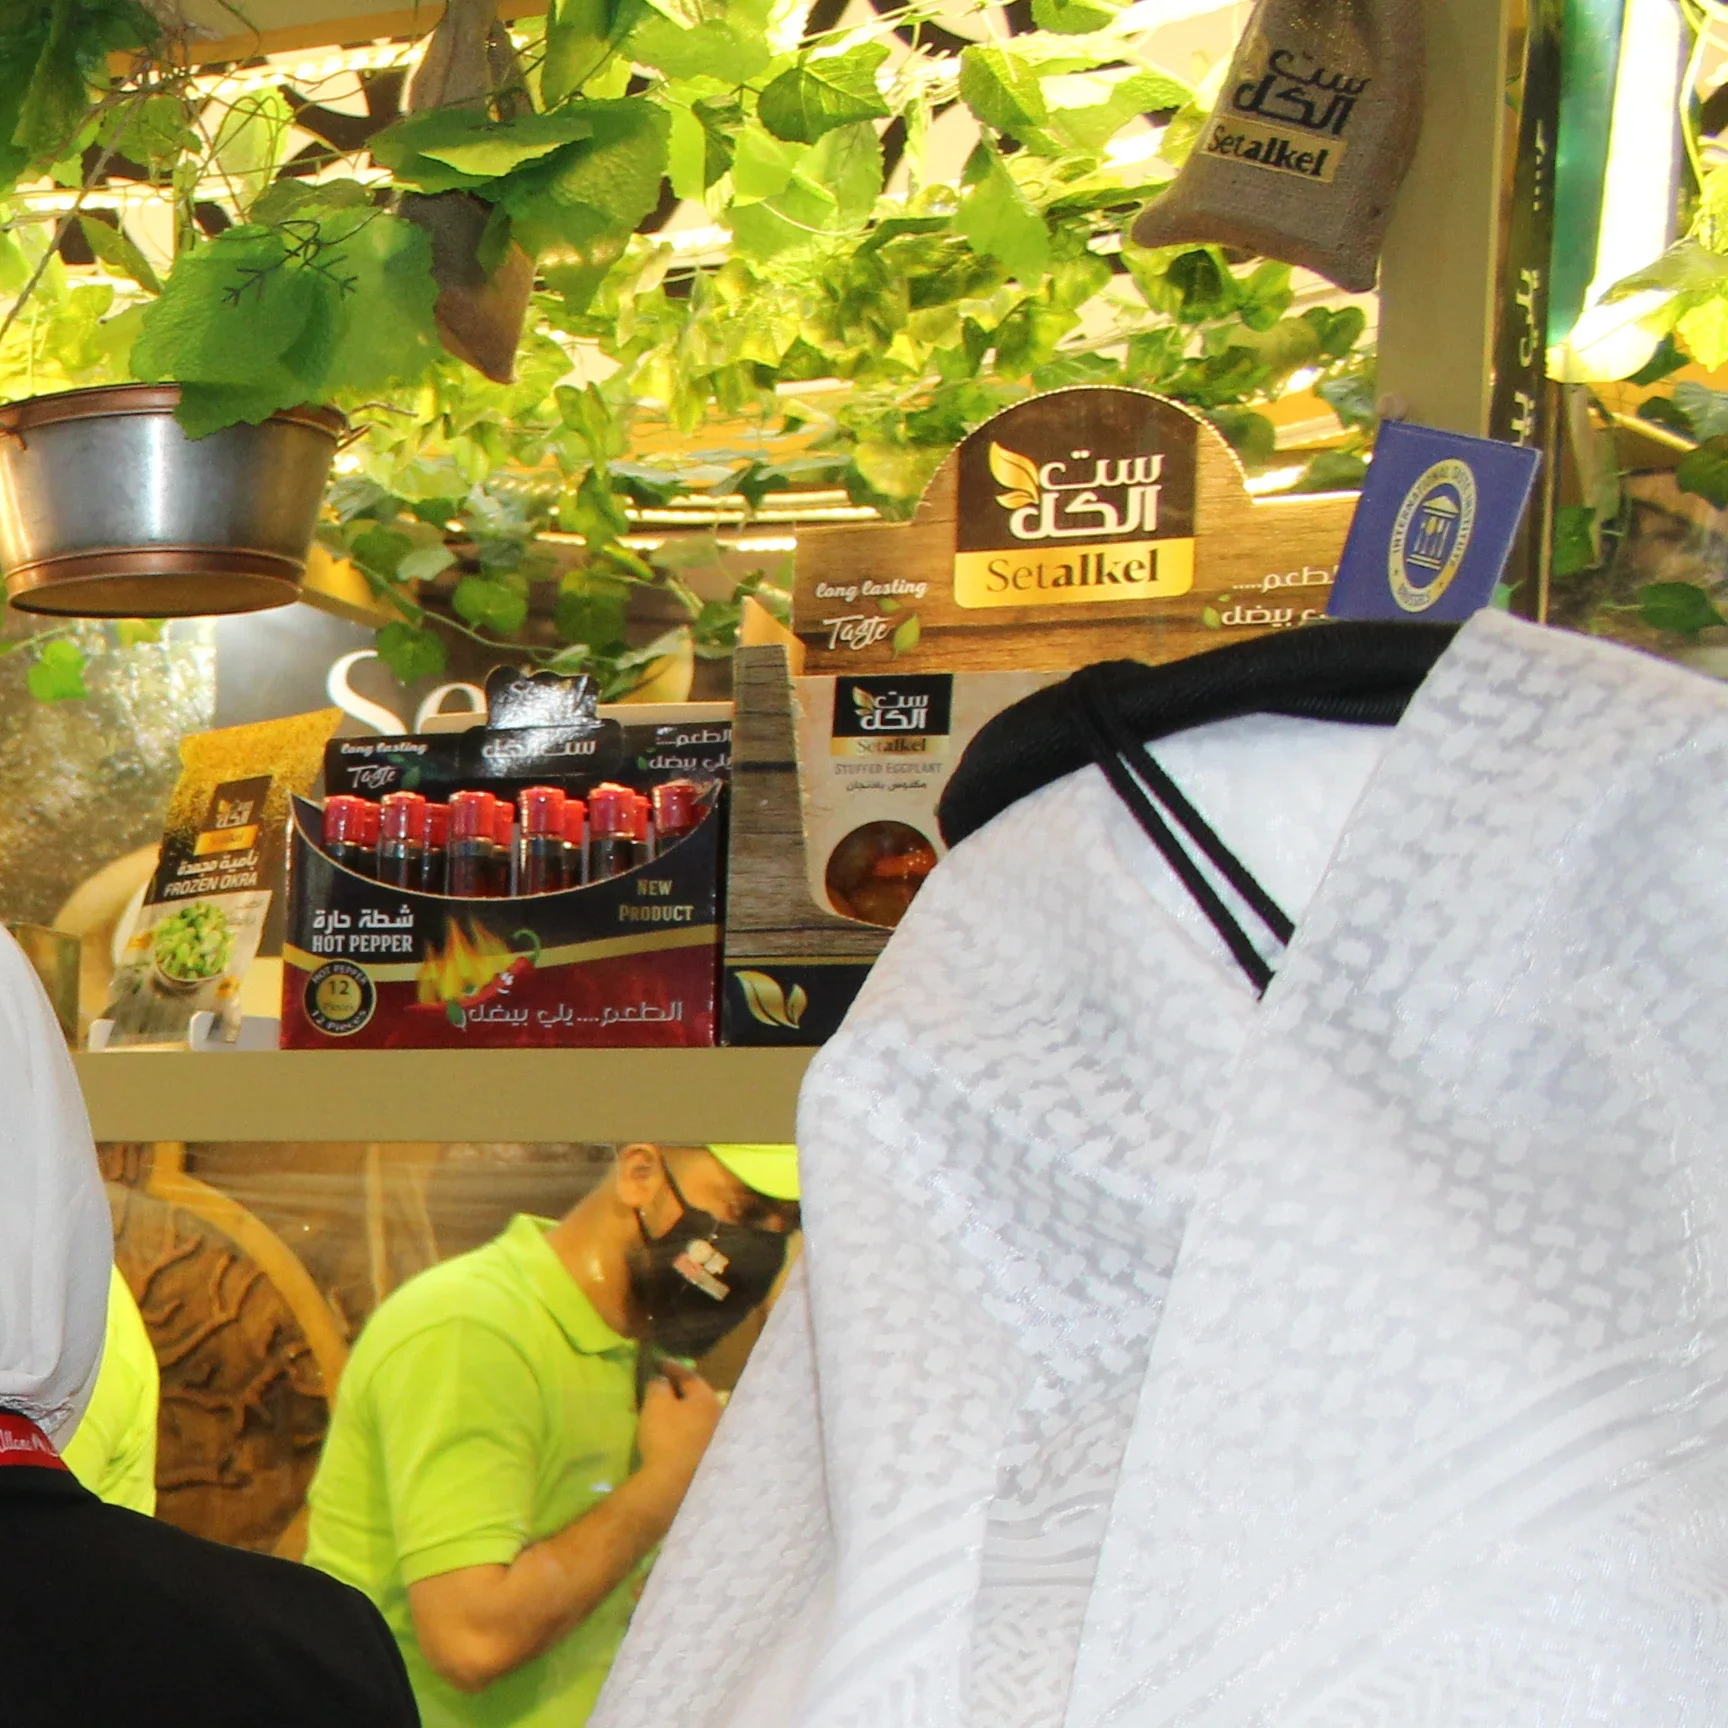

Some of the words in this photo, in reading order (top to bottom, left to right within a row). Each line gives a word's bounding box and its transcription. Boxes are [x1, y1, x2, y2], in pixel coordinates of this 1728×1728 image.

[1269, 49, 1371, 95] ست
[1233, 75, 1356, 135] الكل
[1209, 126, 1328, 176] Setalkel
[1040, 449, 1164, 491] ست
[1009, 484, 1162, 540] الكل
[986, 548, 1160, 593] Setalkel
[823, 613, 894, 651] Taste
[875, 690, 930, 708] ست
[860, 708, 927, 730] الكل
[346, 764, 397, 789] Taste
[834, 762, 882, 775] STUFFED
[886, 762, 942, 775] EGGPLANT
[163, 876, 215, 896] FROZEN
[217, 872, 258, 892] OKRA
[636, 879, 673, 896] NEW
[312, 909, 352, 934] حارة
[357, 904, 414, 929] شطة
[618, 904, 695, 922] PRODUCT
[311, 934, 344, 953] HOT
[348, 934, 414, 953] PEPPER
[328, 980, 350, 997] 12
